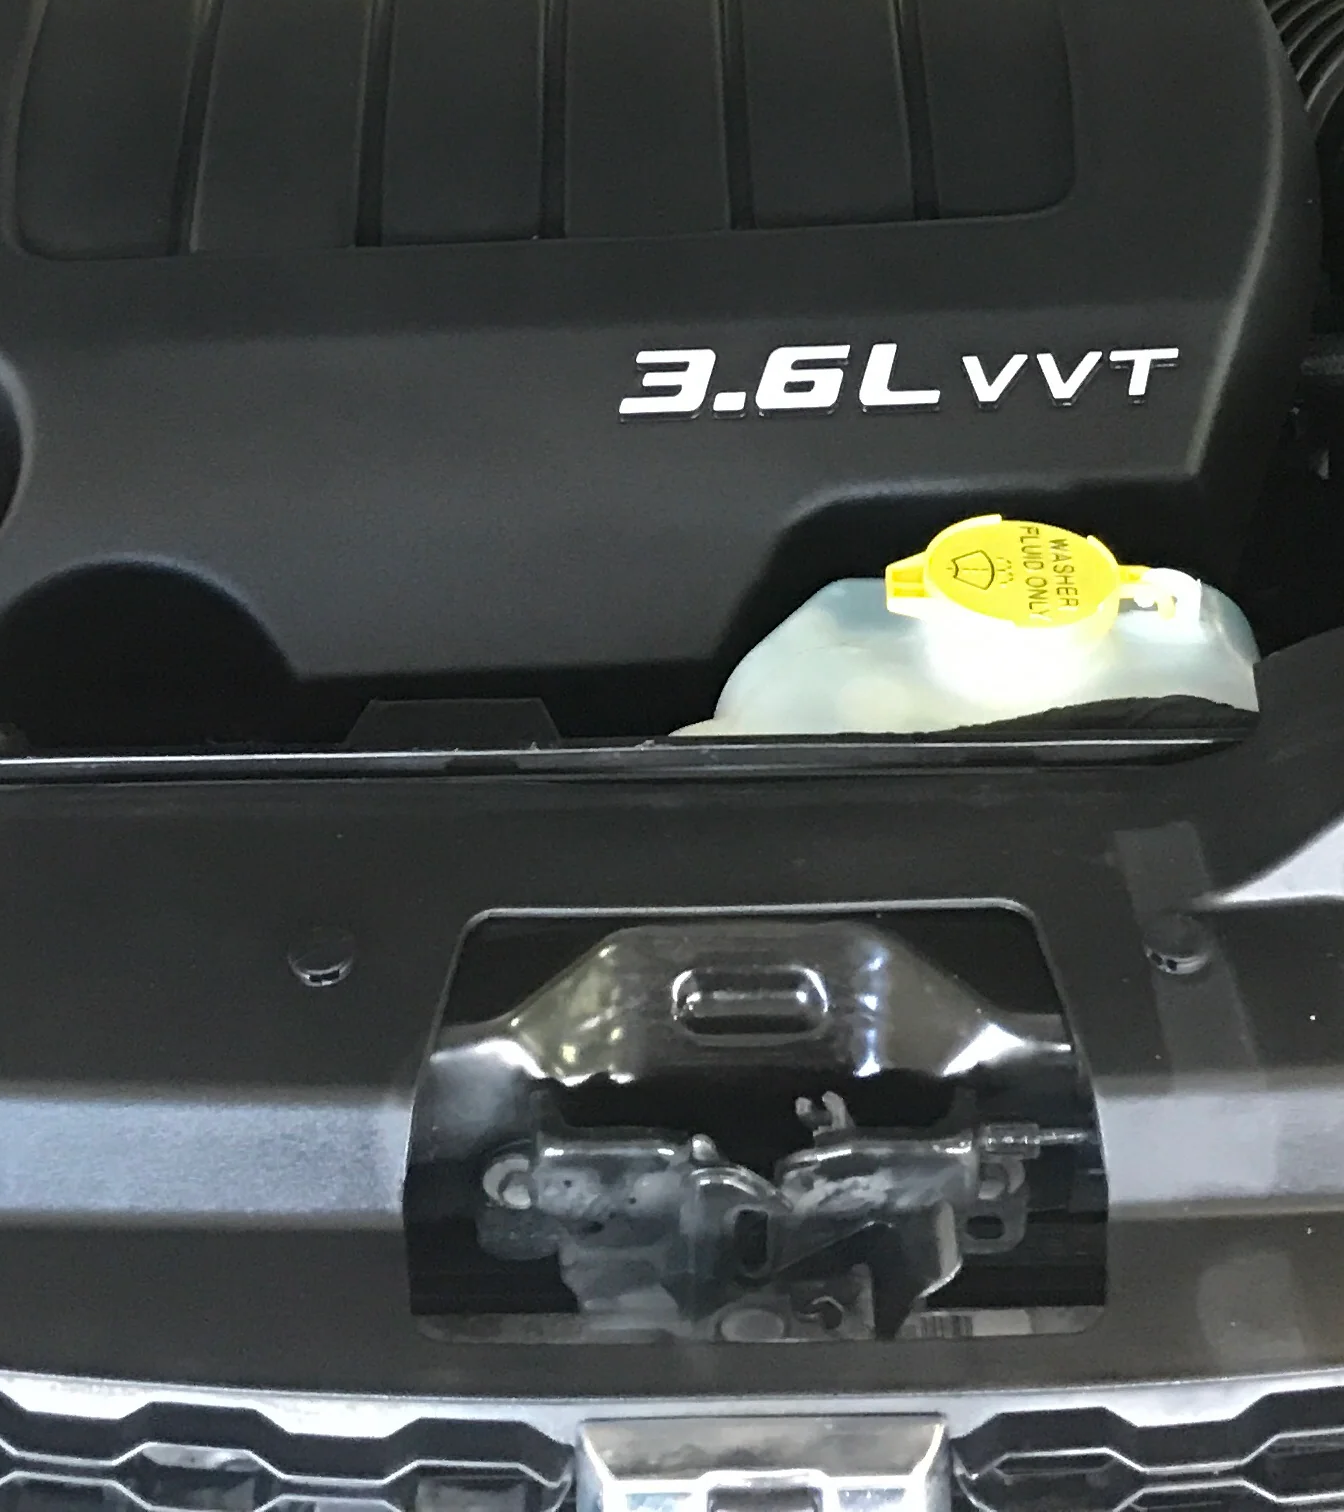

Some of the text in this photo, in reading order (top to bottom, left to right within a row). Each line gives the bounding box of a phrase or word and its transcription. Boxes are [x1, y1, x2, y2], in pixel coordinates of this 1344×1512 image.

[618, 342, 1180, 422] 3.6L VVT
[1019, 526, 1052, 621] FLUID ONLY
[1049, 538, 1079, 611] WASHER
